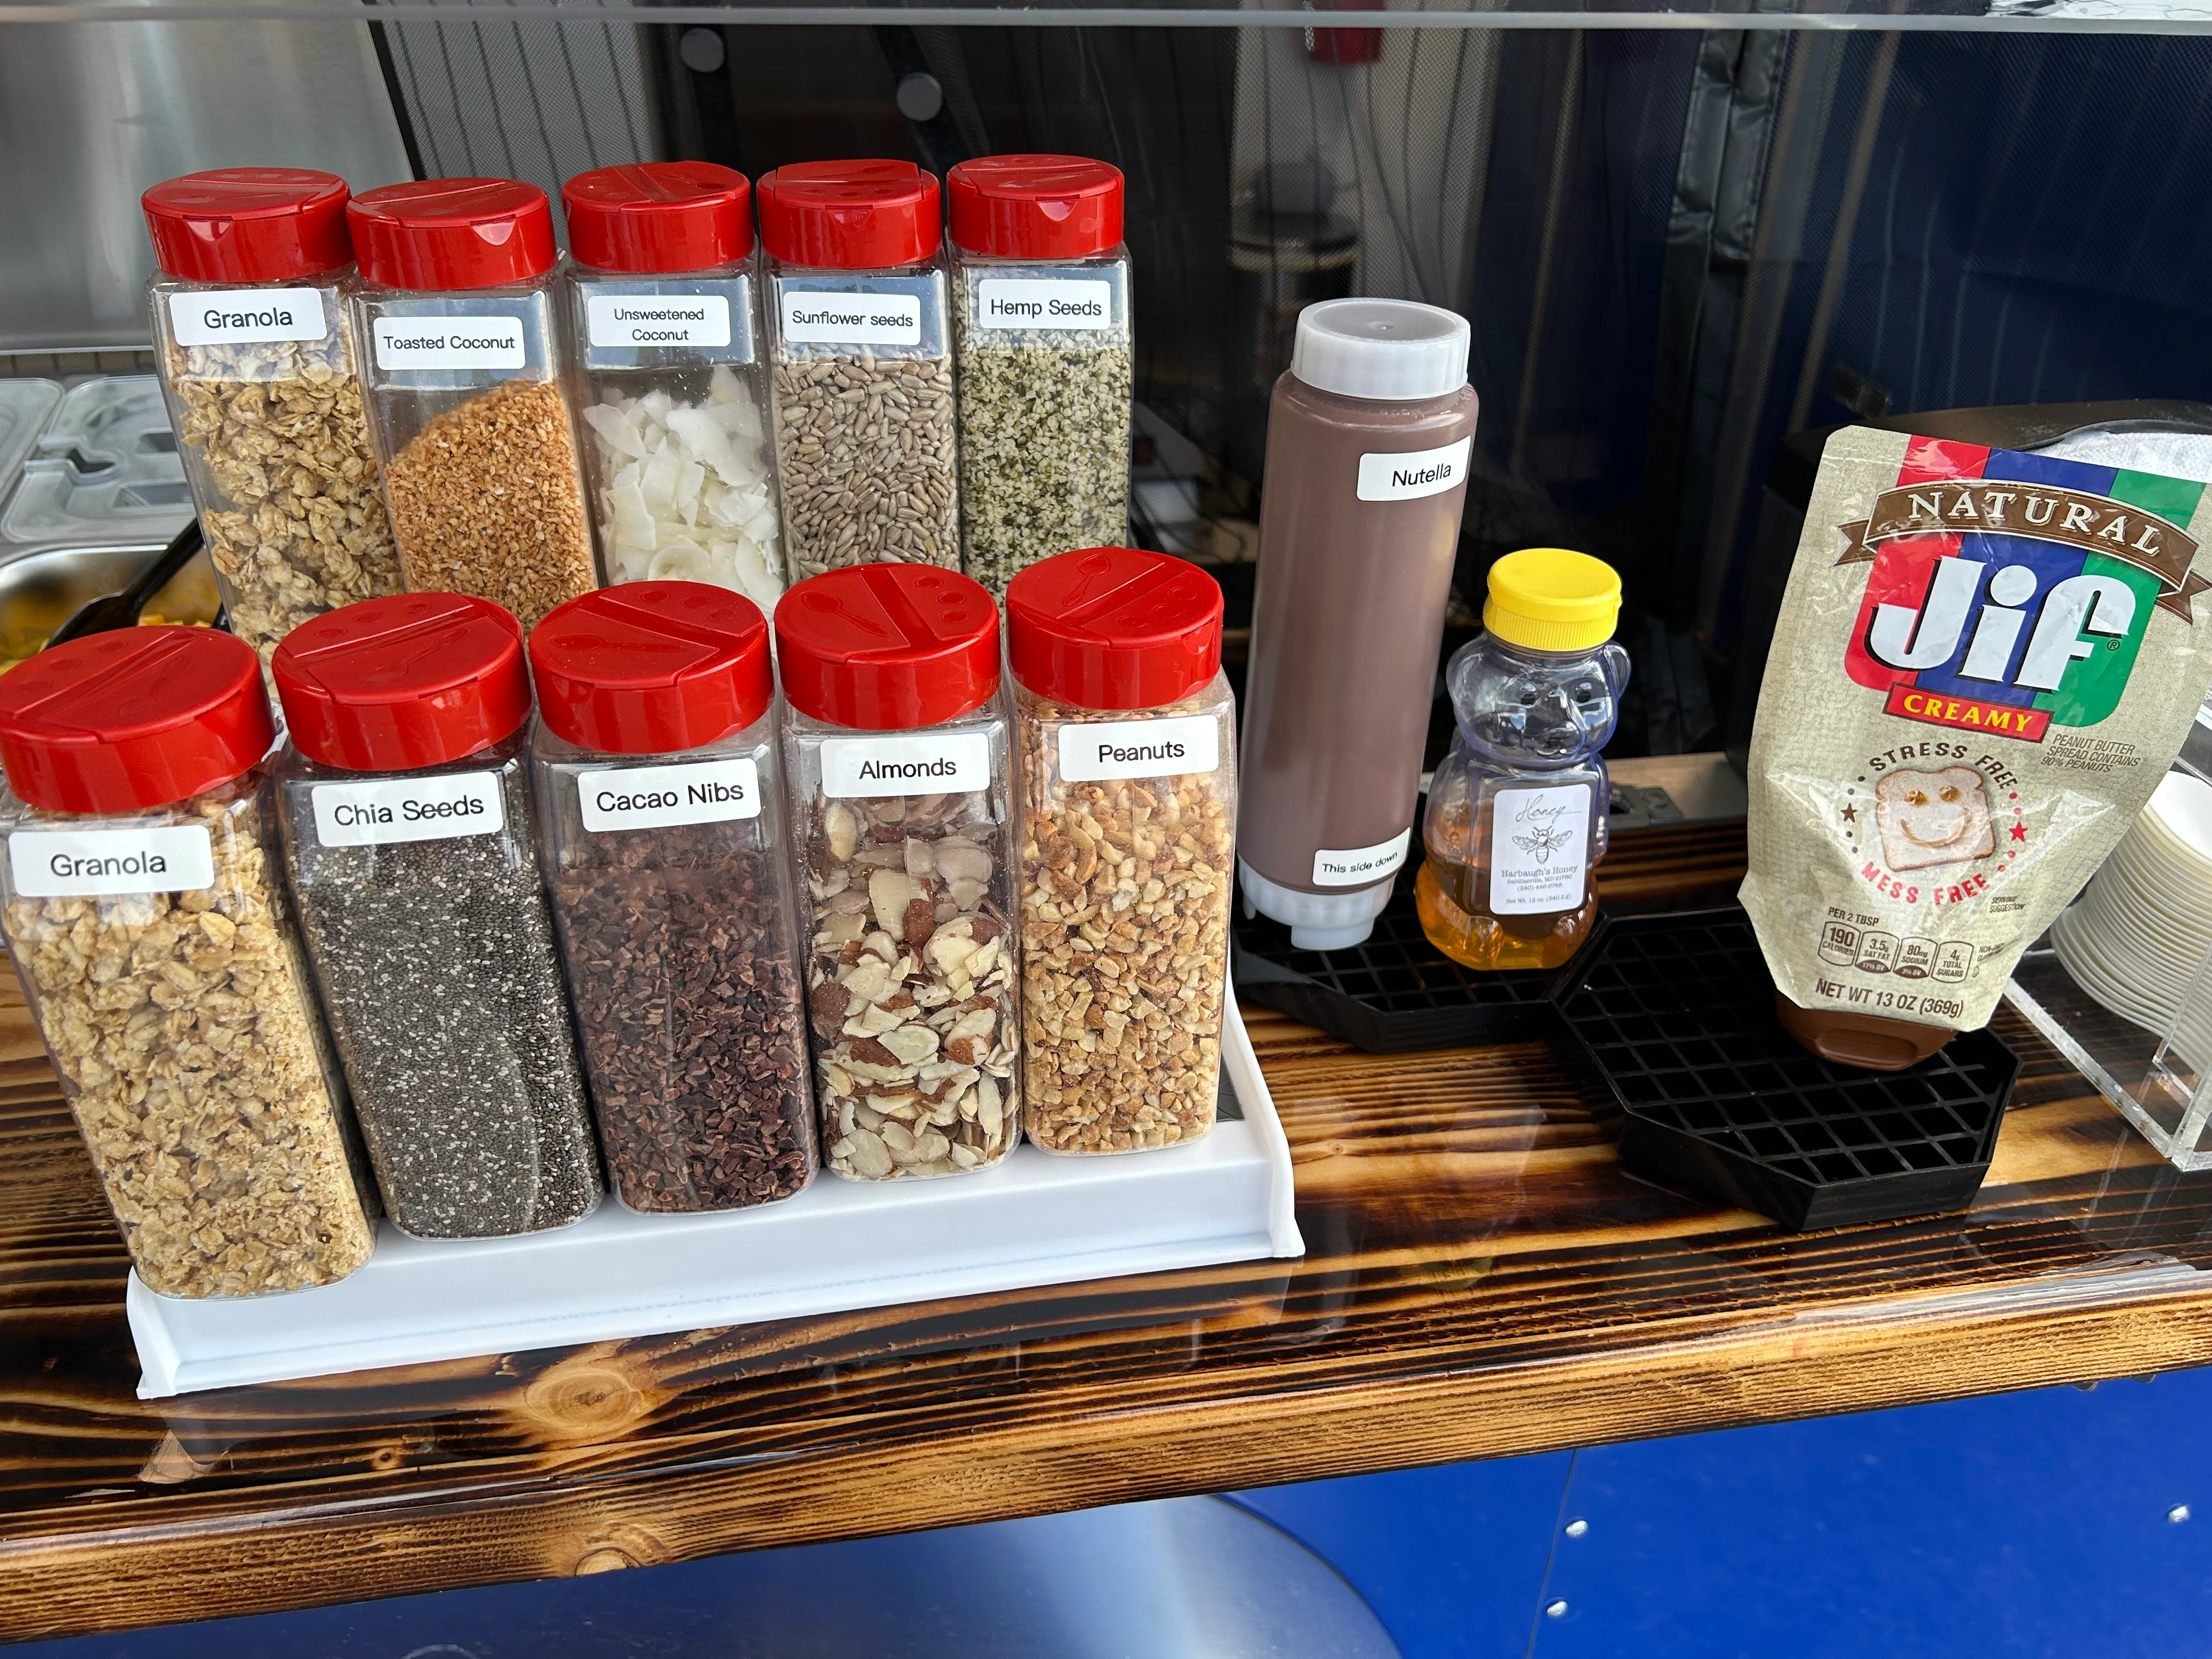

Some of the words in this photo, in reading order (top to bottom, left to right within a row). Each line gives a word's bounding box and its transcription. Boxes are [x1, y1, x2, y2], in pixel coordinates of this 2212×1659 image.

[204, 307, 293, 329] Granola
[614, 308, 704, 320] Unsweetened
[792, 310, 866, 325] Sunflower
[870, 313, 913, 327] seeds
[991, 298, 1042, 319] Hemp
[1048, 299, 1102, 316] Seeds
[383, 336, 445, 349] Toasted
[450, 335, 516, 349] Coconut
[632, 329, 689, 341] Coconut
[1392, 462, 1452, 487] Nutella
[1907, 490, 2162, 557] NATURAL
[1866, 555, 2137, 695] Jif
[1904, 694, 2034, 733] CREAMY
[1098, 741, 1185, 763] Peanuts
[2053, 734, 2096, 749] PEANUT
[2094, 740, 2135, 755] BUTTER
[1869, 742, 1967, 771] STRESS
[1975, 754, 2018, 789] FREE
[2041, 757, 2063, 766] 90%
[2065, 759, 2113, 773] PEANUTS
[2047, 746, 2089, 760] SPREAD
[2089, 752, 2141, 766] CONTAINS
[859, 757, 957, 780] Almonds
[596, 790, 678, 812] Cacao
[688, 782, 744, 805] Nibs
[334, 804, 393, 827] Chia
[402, 795, 485, 821] Seeds
[1515, 794, 1582, 824] Honey
[50, 850, 167, 877] Granola
[1322, 863, 1346, 873] This
[1350, 861, 1372, 871] side
[1375, 851, 1397, 867] down
[1501, 868, 1550, 877] Harbaugh's
[1553, 865, 1578, 875] Honey
[1861, 861, 1918, 904] MESS
[1934, 873, 1990, 905] FREE
[1828, 906, 1846, 919] PER
[1847, 913, 1853, 921] 2
[1855, 914, 1879, 926] TBSP
[1830, 927, 1854, 946] 190
[1822, 941, 1854, 956] CALORIES
[1877, 952, 1891, 961] FAT
[1901, 956, 1928, 965] SODIUM
[1943, 961, 1962, 969] TOTAL
[1937, 968, 1964, 977] SUGARS
[1815, 978, 1846, 998] NET
[1849, 986, 1872, 1003] WT
[1876, 991, 1893, 1007] 13
[1897, 994, 1918, 1011] OZ
[1920, 996, 1964, 1019] (369g)
